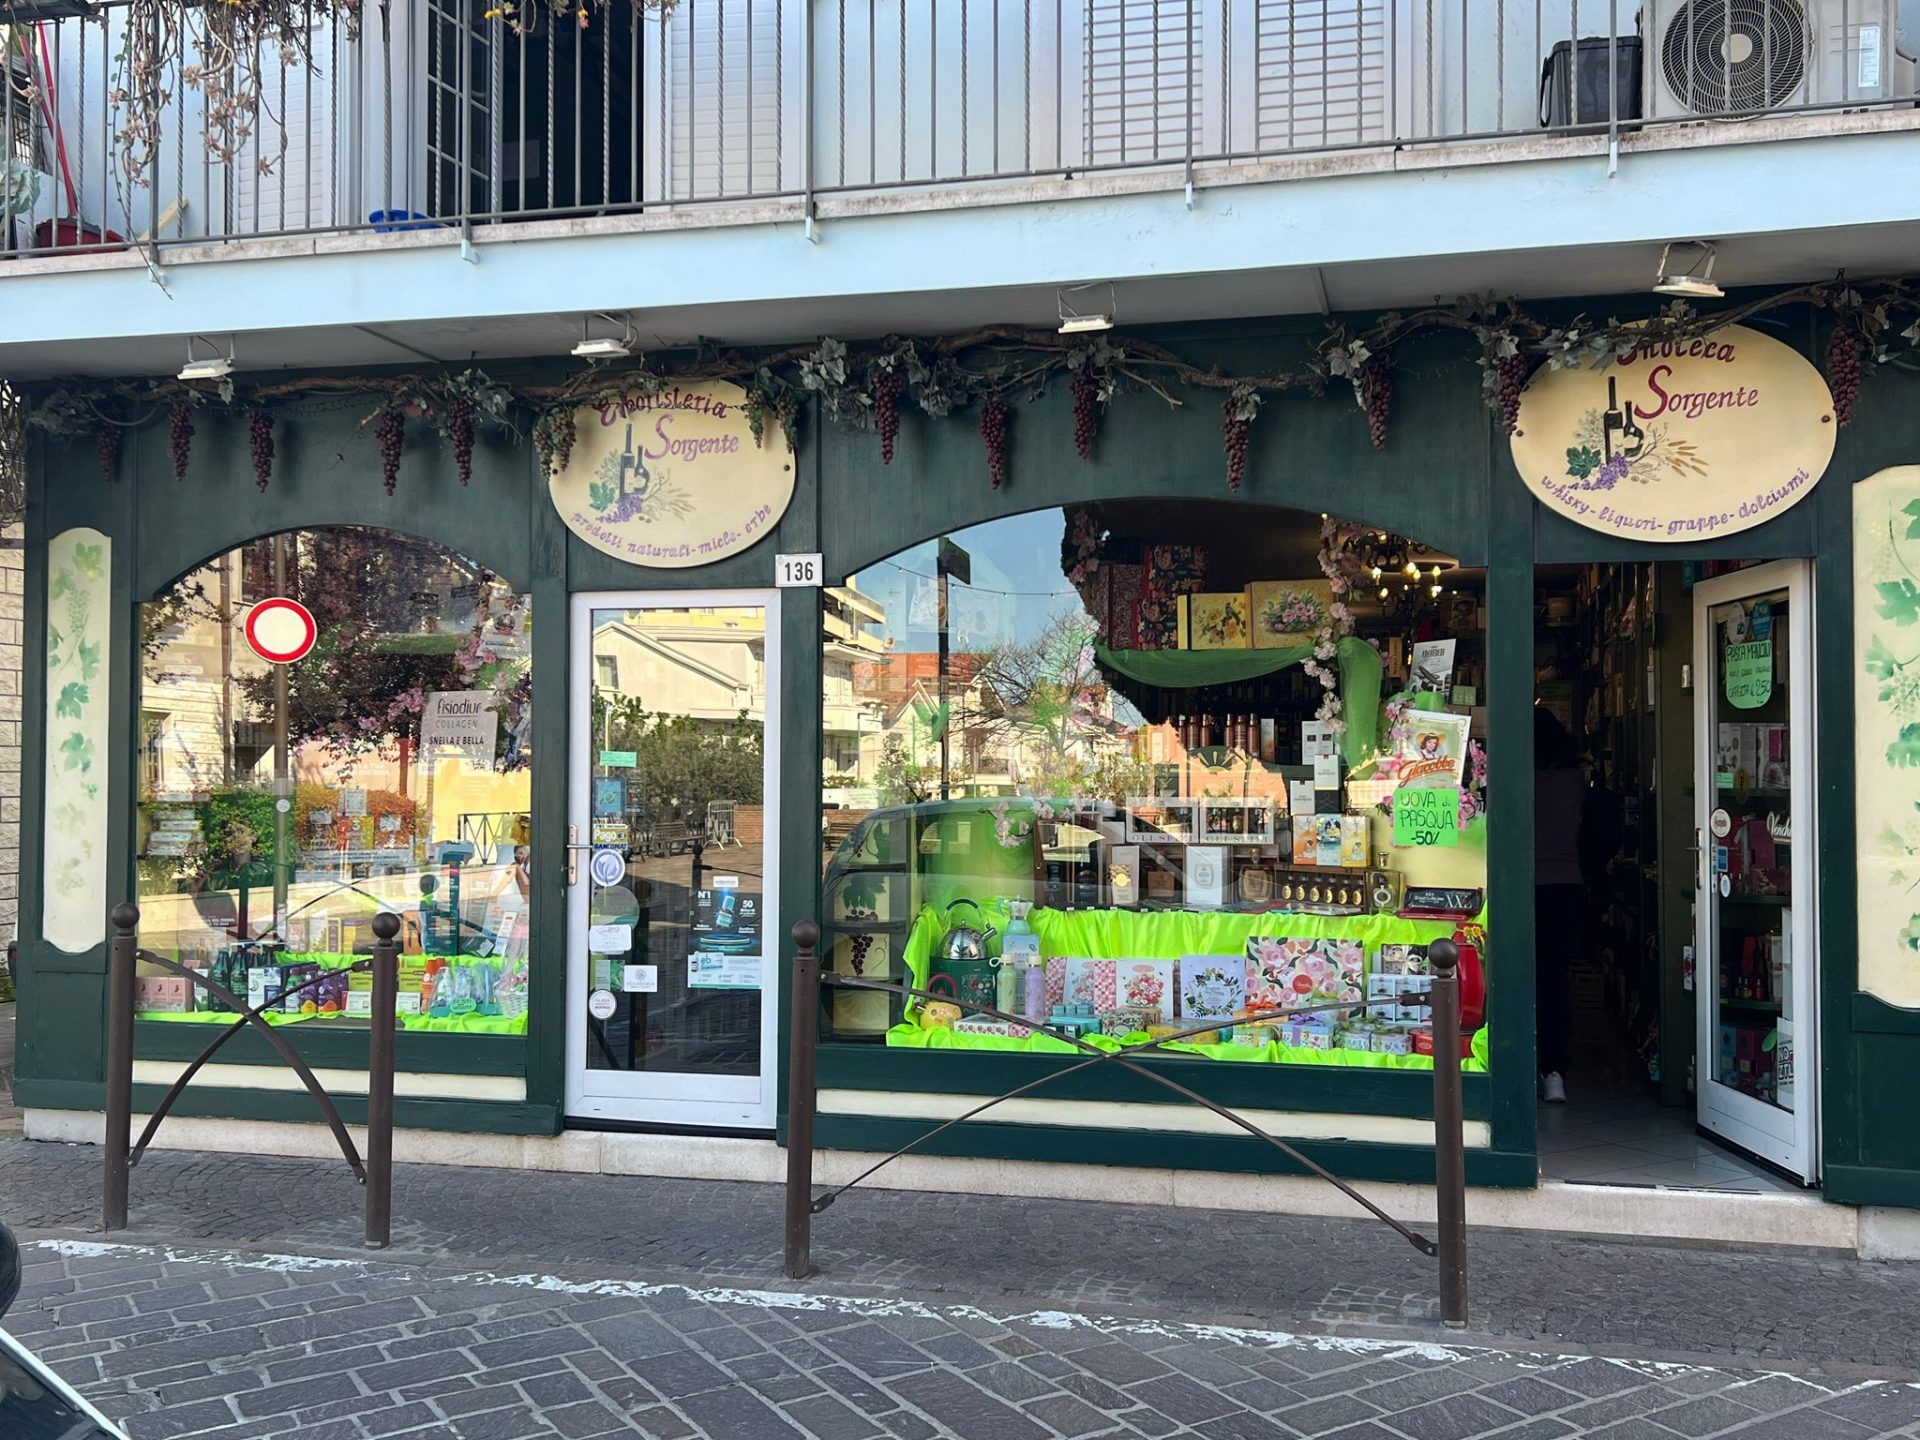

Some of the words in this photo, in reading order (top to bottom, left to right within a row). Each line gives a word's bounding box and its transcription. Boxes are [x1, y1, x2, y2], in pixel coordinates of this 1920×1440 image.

[1634, 365, 1758, 419] Sorgente
[643, 413, 740, 462] Sorgente
[1739, 467, 1809, 518] dolciumi
[745, 504, 772, 533] erbe
[784, 562, 814, 582] 136
[436, 720, 478, 728] COLLAGEN
[429, 736, 454, 745] SNELLA
[456, 736, 460, 745] E
[462, 736, 484, 745] BELLA
[1397, 756, 1456, 788] Giacobbe
[1401, 792, 1436, 807] UOVA
[1400, 809, 1454, 829] PASQUA
[594, 829, 617, 842] Pago
[1411, 831, 1440, 845] -50%
[742, 900, 753, 908] 50
